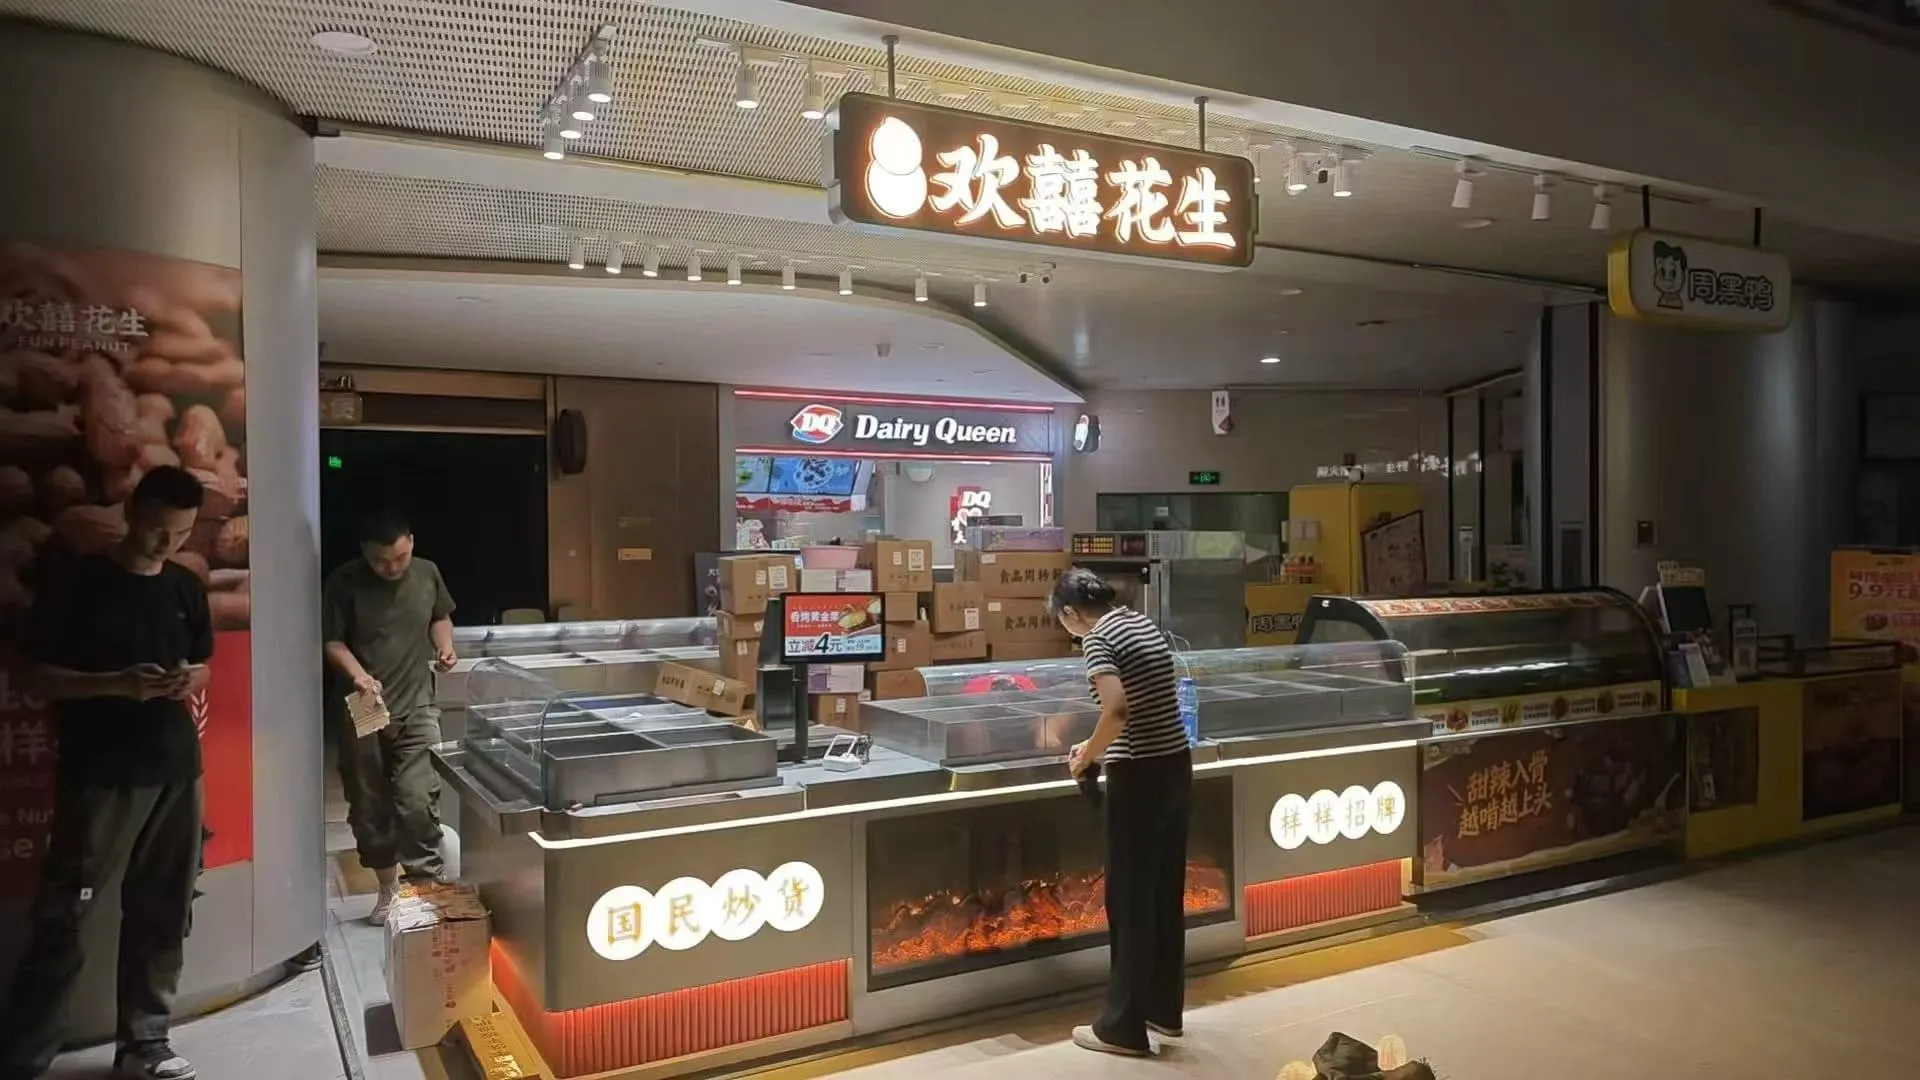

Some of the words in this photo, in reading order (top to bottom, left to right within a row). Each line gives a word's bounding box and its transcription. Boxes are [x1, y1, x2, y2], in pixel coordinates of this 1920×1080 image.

[928, 133, 1237, 249] 欢囍花生
[1688, 269, 1774, 312] 周黑鸭
[18, 335, 54, 349] FUN
[58, 337, 131, 354] PEANUT
[802, 412, 839, 434] DQ
[854, 413, 930, 446] Dairy
[935, 416, 1017, 445] Queen
[961, 490, 992, 508] DQ
[1466, 749, 1548, 804] 甜辣入骨
[1280, 791, 1398, 841] 样样招牌
[1457, 782, 1552, 840] 越啃越上头
[607, 876, 810, 946] 国民炒货
